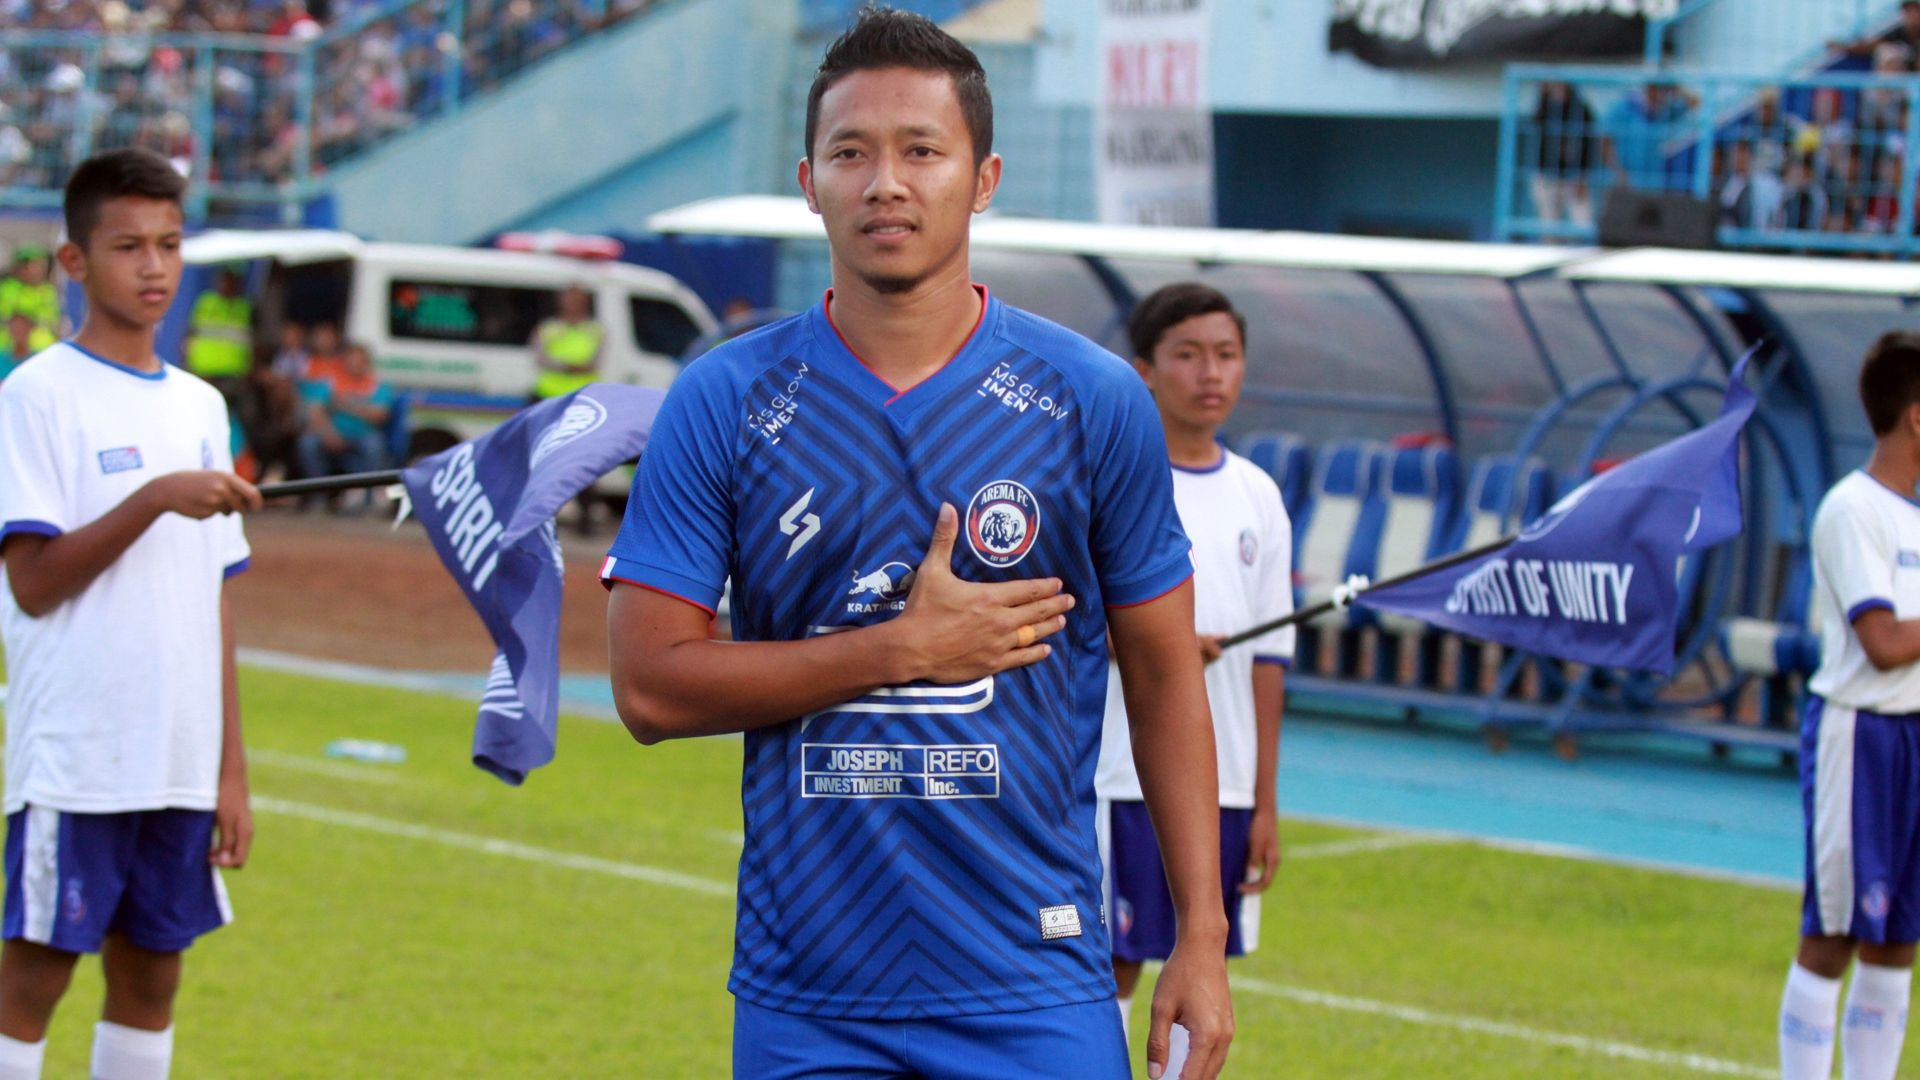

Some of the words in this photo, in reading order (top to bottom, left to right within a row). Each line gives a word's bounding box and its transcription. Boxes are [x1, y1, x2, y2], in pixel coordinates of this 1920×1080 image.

[771, 362, 808, 409] GLOW
[991, 366, 1019, 388] MS
[1019, 383, 1068, 420] GLOW
[981, 484, 1015, 505] AREMA
[1017, 488, 1029, 507] FC
[1446, 558, 1518, 616] SPIRIT
[1513, 558, 1550, 618] OF
[1547, 560, 1634, 625] UNITY
[826, 750, 904, 771] JOSEPH
[929, 750, 995, 772] REFO
[814, 776, 903, 793] INVESTMENT
[929, 778, 960, 795] Inc.
